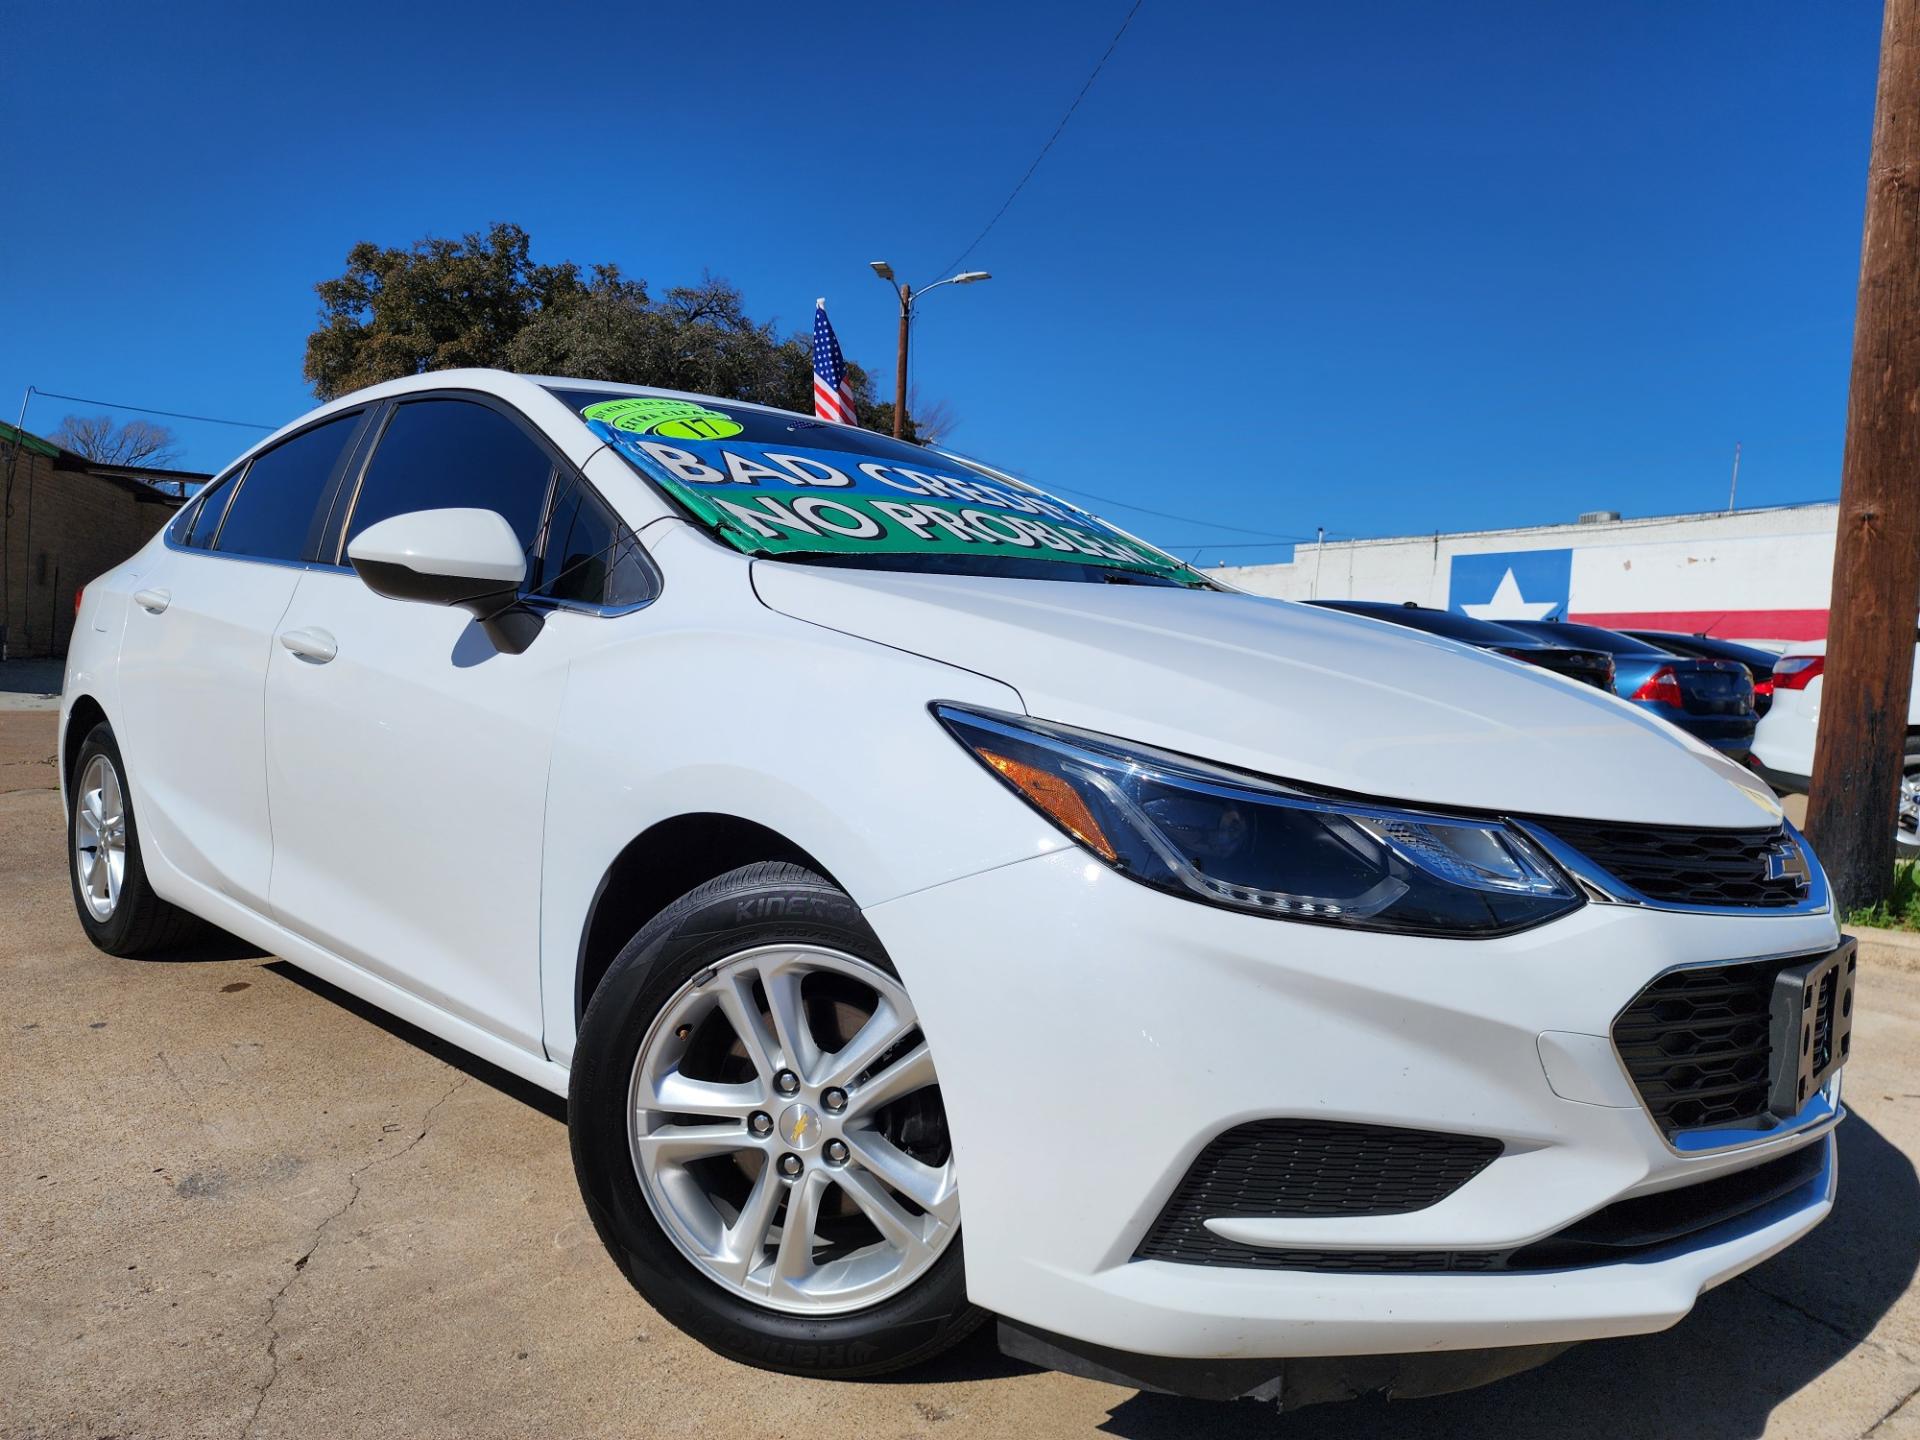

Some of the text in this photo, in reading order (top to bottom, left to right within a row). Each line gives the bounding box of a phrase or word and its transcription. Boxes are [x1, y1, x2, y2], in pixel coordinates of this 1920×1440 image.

[620, 413, 660, 430] EXTRA
[679, 418, 720, 438] 17
[635, 441, 851, 488] BAD
[711, 496, 1160, 566] NO PROBLEM
